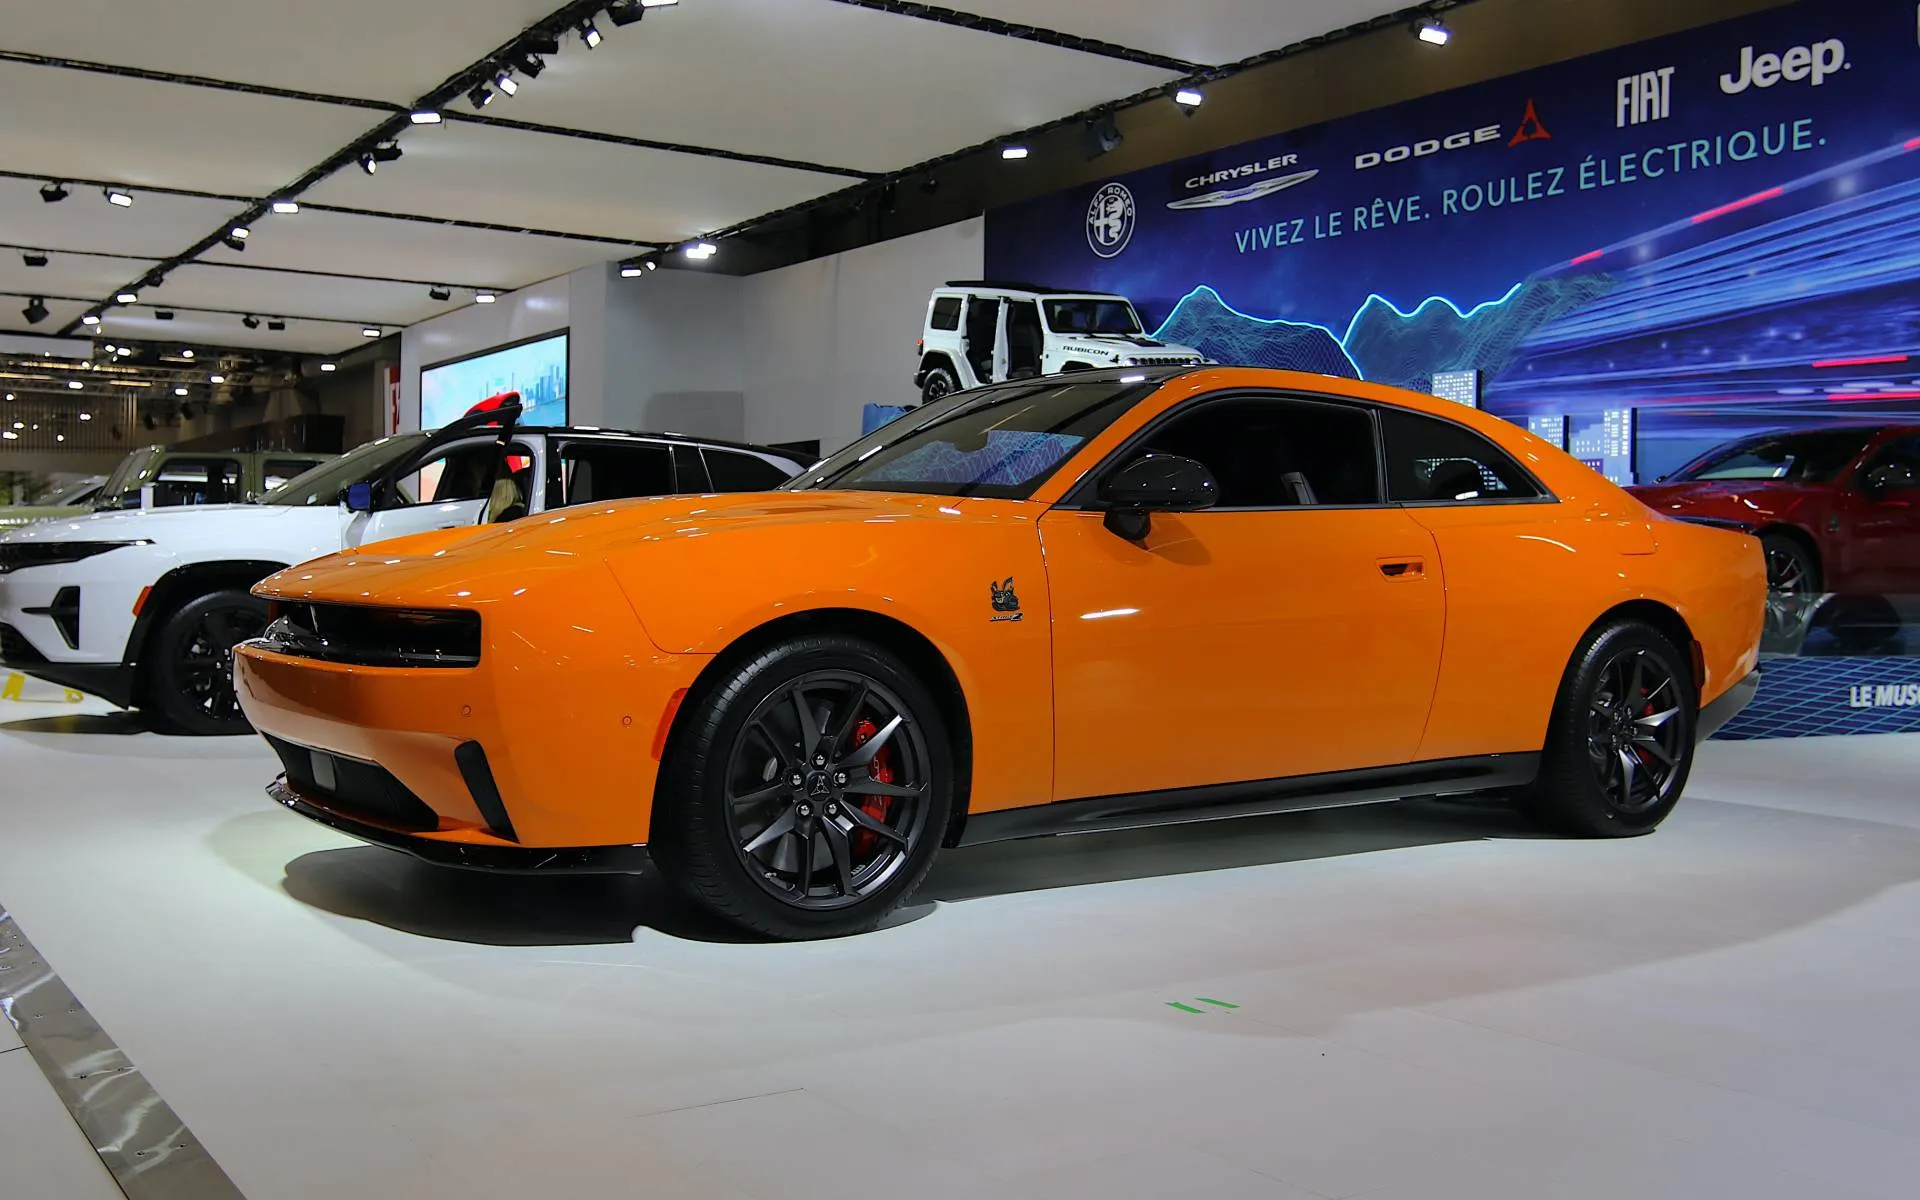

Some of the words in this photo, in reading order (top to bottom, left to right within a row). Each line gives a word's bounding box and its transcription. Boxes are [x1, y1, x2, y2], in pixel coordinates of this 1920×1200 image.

[1616, 66, 1675, 128] FIAT
[1355, 124, 1501, 170] DODGE
[1185, 153, 1298, 189] CHRYSLER
[1235, 219, 1304, 254] VIVEZ
[1314, 211, 1342, 239] LE
[1353, 196, 1430, 232] RÊVE.
[1443, 168, 1565, 215] ROULEZ
[1578, 118, 1827, 190] ÉLECTRIQUE.
[1088, 194, 1104, 225] ALFA
[1107, 186, 1133, 217] ROMEO
[1063, 345, 1109, 356] RUBICON
[1850, 685, 1872, 707] LE
[1874, 684, 1920, 706] MUS
